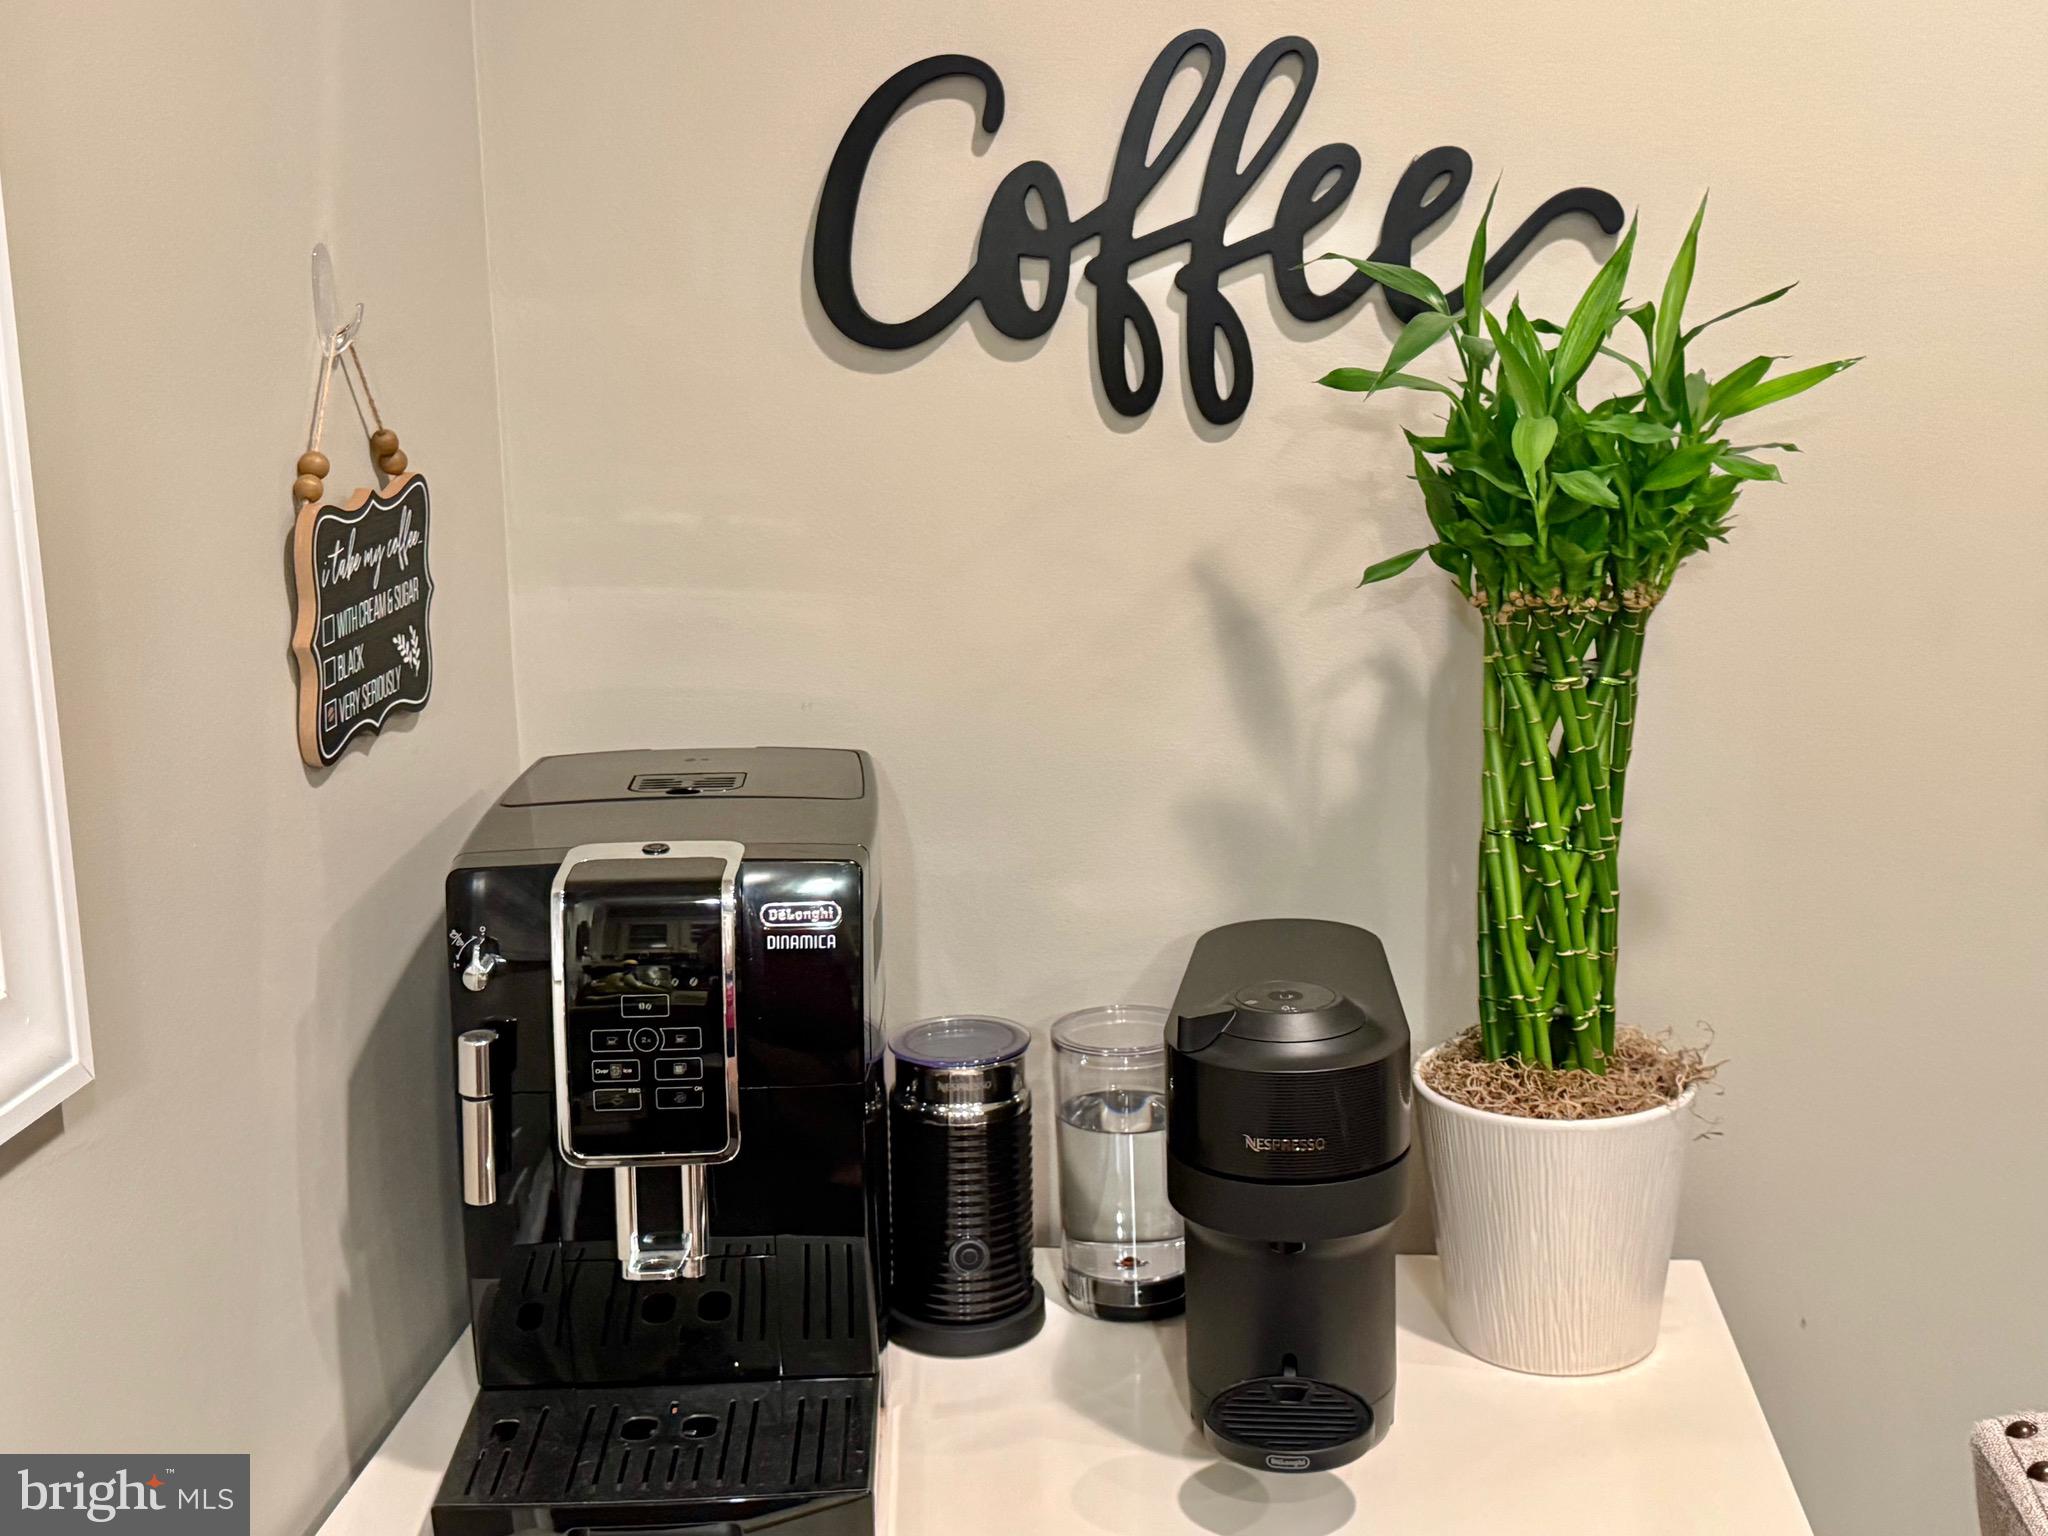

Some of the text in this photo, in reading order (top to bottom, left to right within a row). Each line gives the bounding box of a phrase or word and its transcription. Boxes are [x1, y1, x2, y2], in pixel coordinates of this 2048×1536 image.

[813, 29, 1625, 425] Coffee
[328, 527, 362, 585] take
[363, 544, 386, 590] my
[336, 577, 419, 639] WITH CREAM & SUGAR
[338, 643, 365, 681] BLACK
[338, 665, 402, 723] VERY SERIOUSLY
[766, 934, 837, 950] DINAMICA
[1242, 1133, 1326, 1152] NESPRESSO
